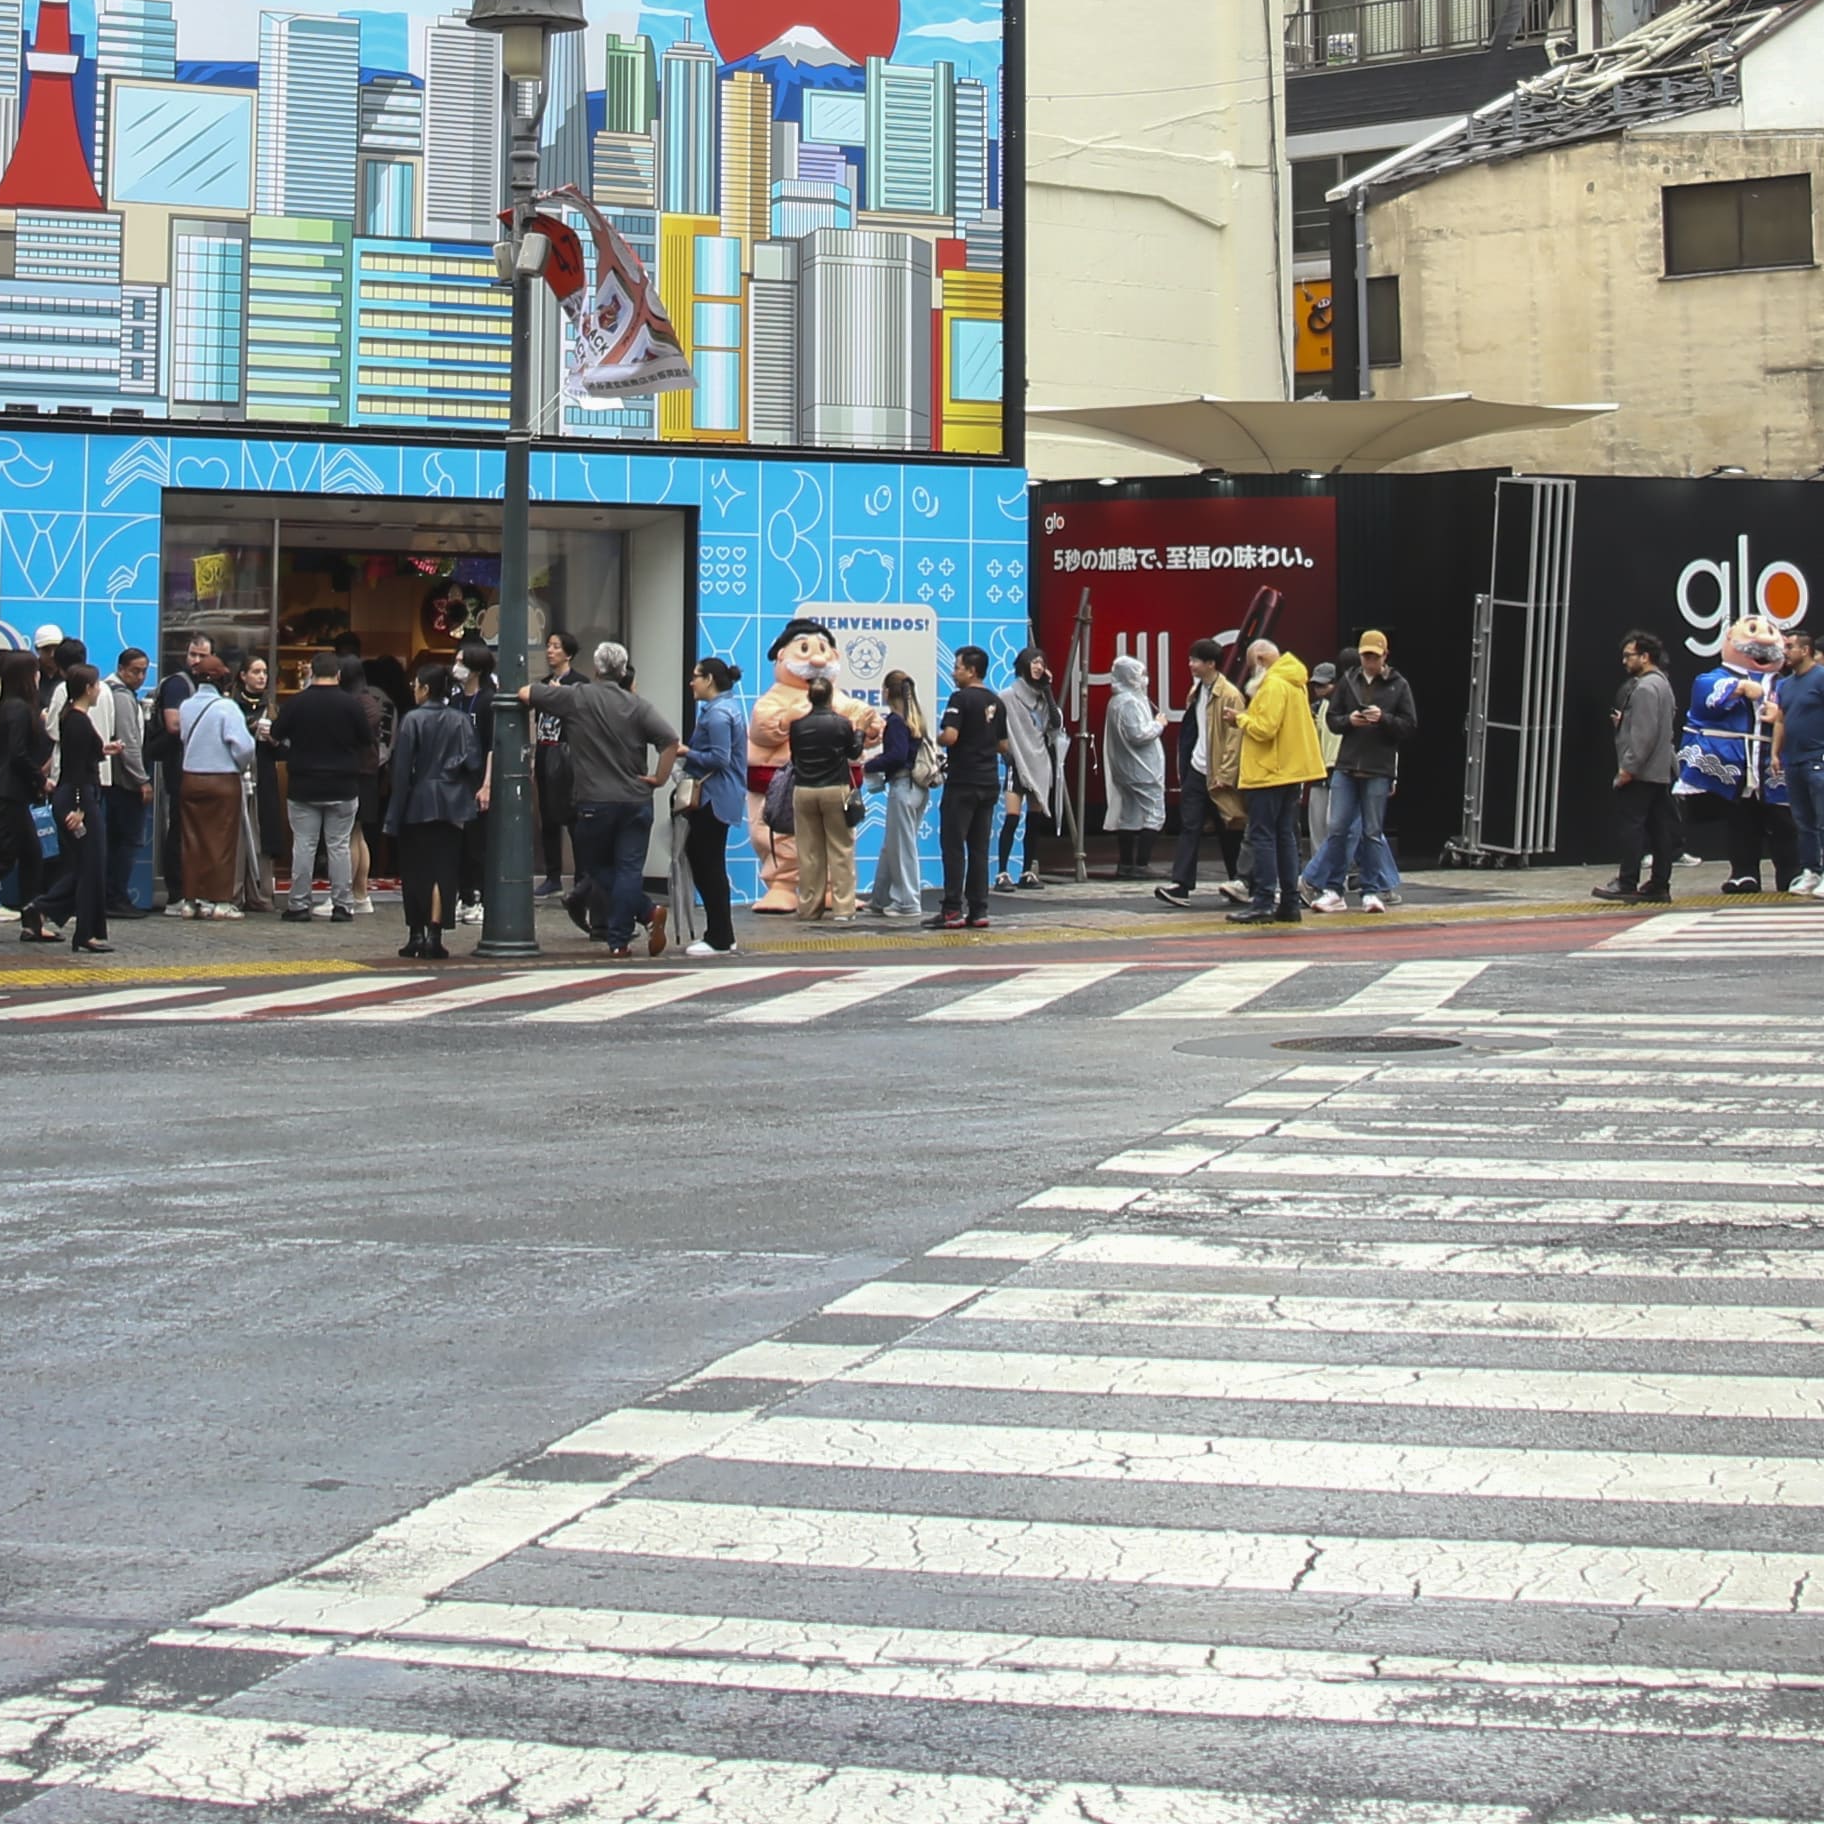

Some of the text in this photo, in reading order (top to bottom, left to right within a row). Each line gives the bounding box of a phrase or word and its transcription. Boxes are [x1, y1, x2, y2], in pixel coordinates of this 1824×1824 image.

[1044, 512, 1065, 535] glo
[1053, 544, 1314, 573] 5秒の加熱で、至福の味わい。
[1676, 534, 1809, 658] glo
